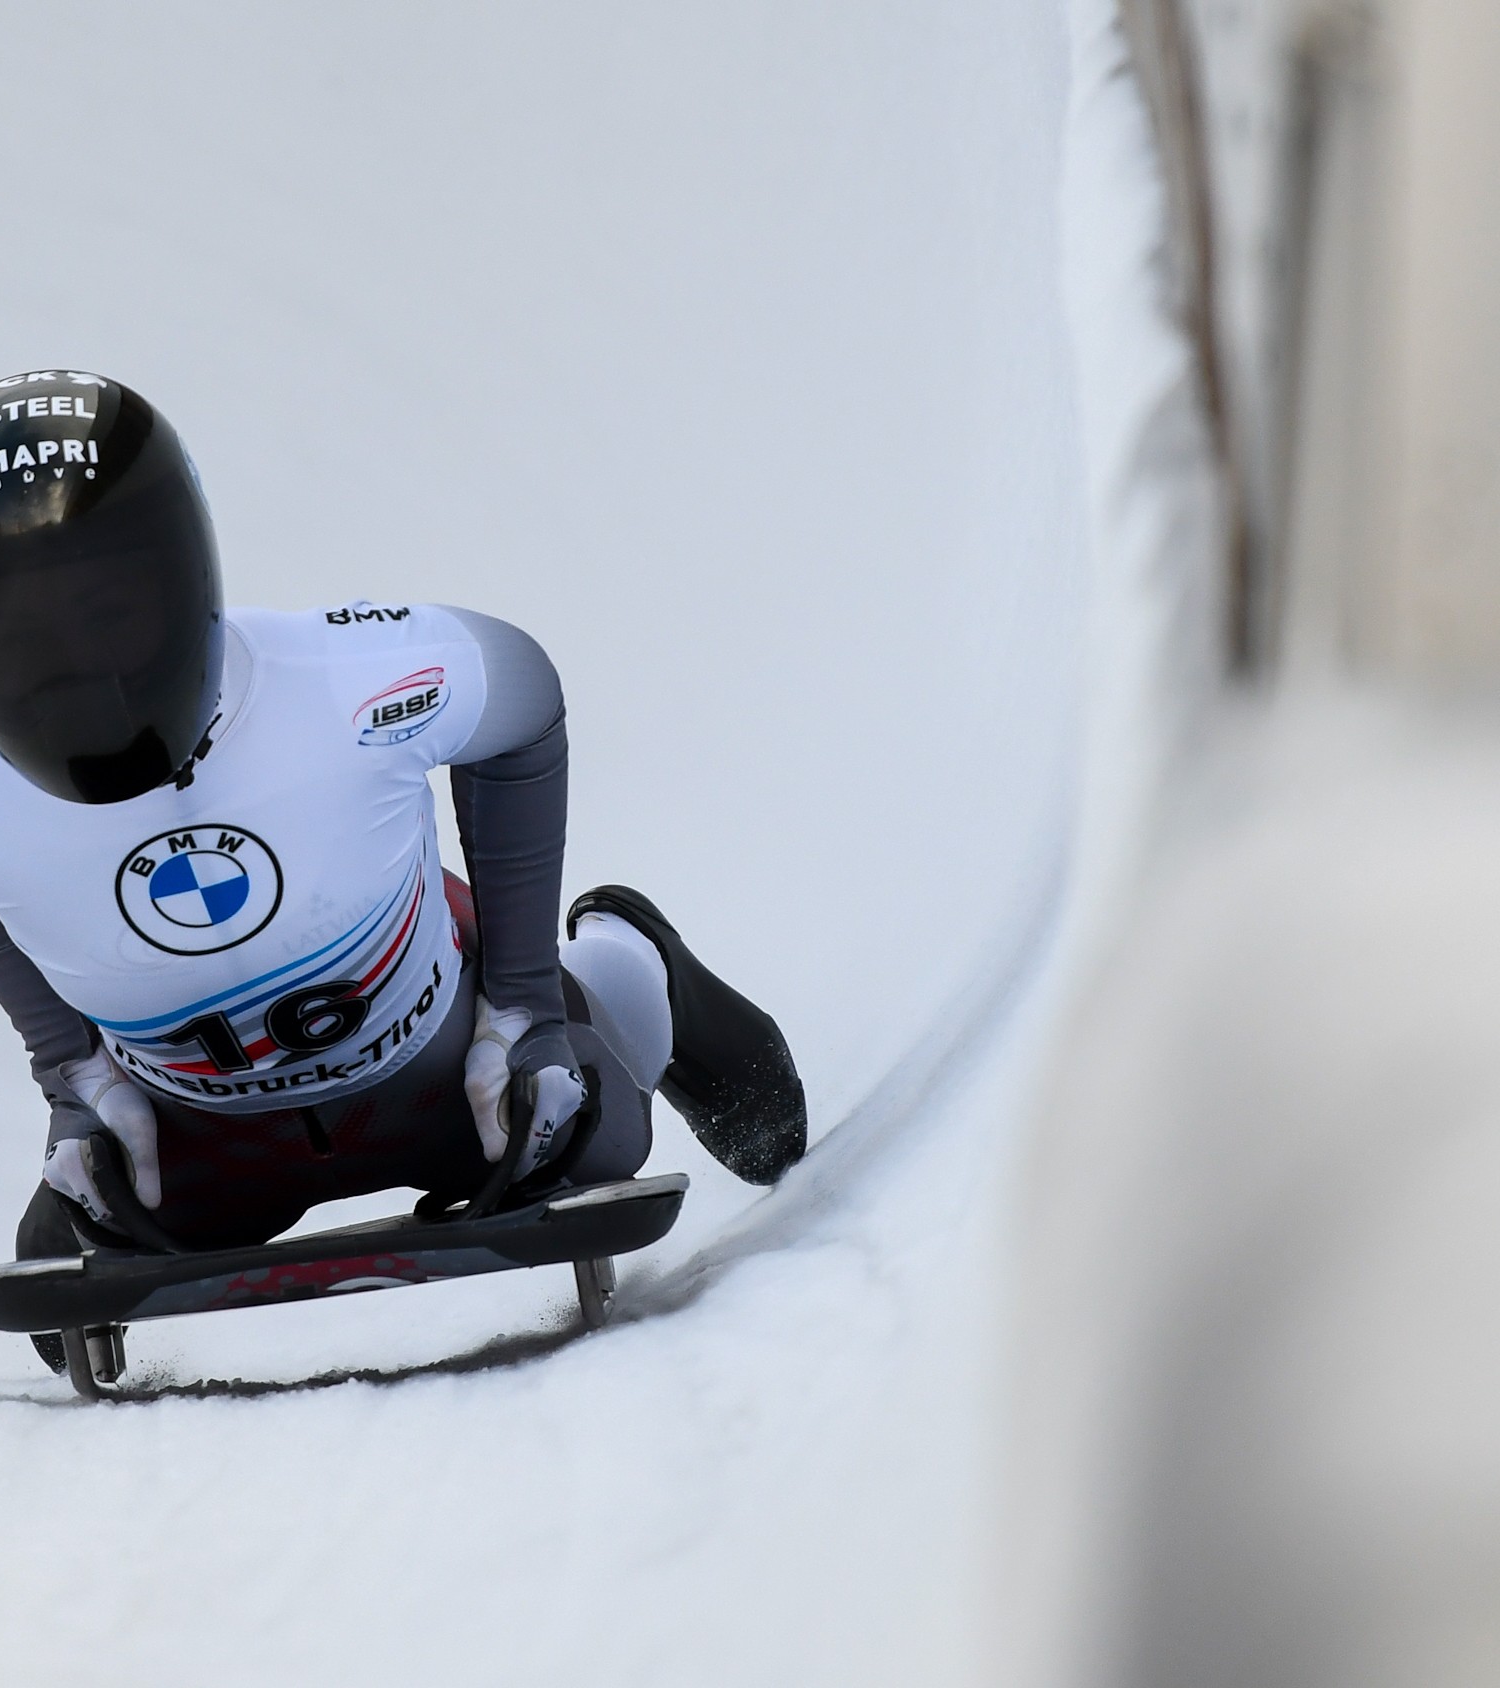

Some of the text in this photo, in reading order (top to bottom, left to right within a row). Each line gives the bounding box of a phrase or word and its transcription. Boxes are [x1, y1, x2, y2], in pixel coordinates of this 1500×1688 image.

[325, 606, 411, 625] BMW
[372, 687, 440, 724] IBSF
[129, 832, 246, 878] BMW
[114, 959, 442, 1097] Innsbruck-Tirol
[160, 980, 372, 1073] 16
